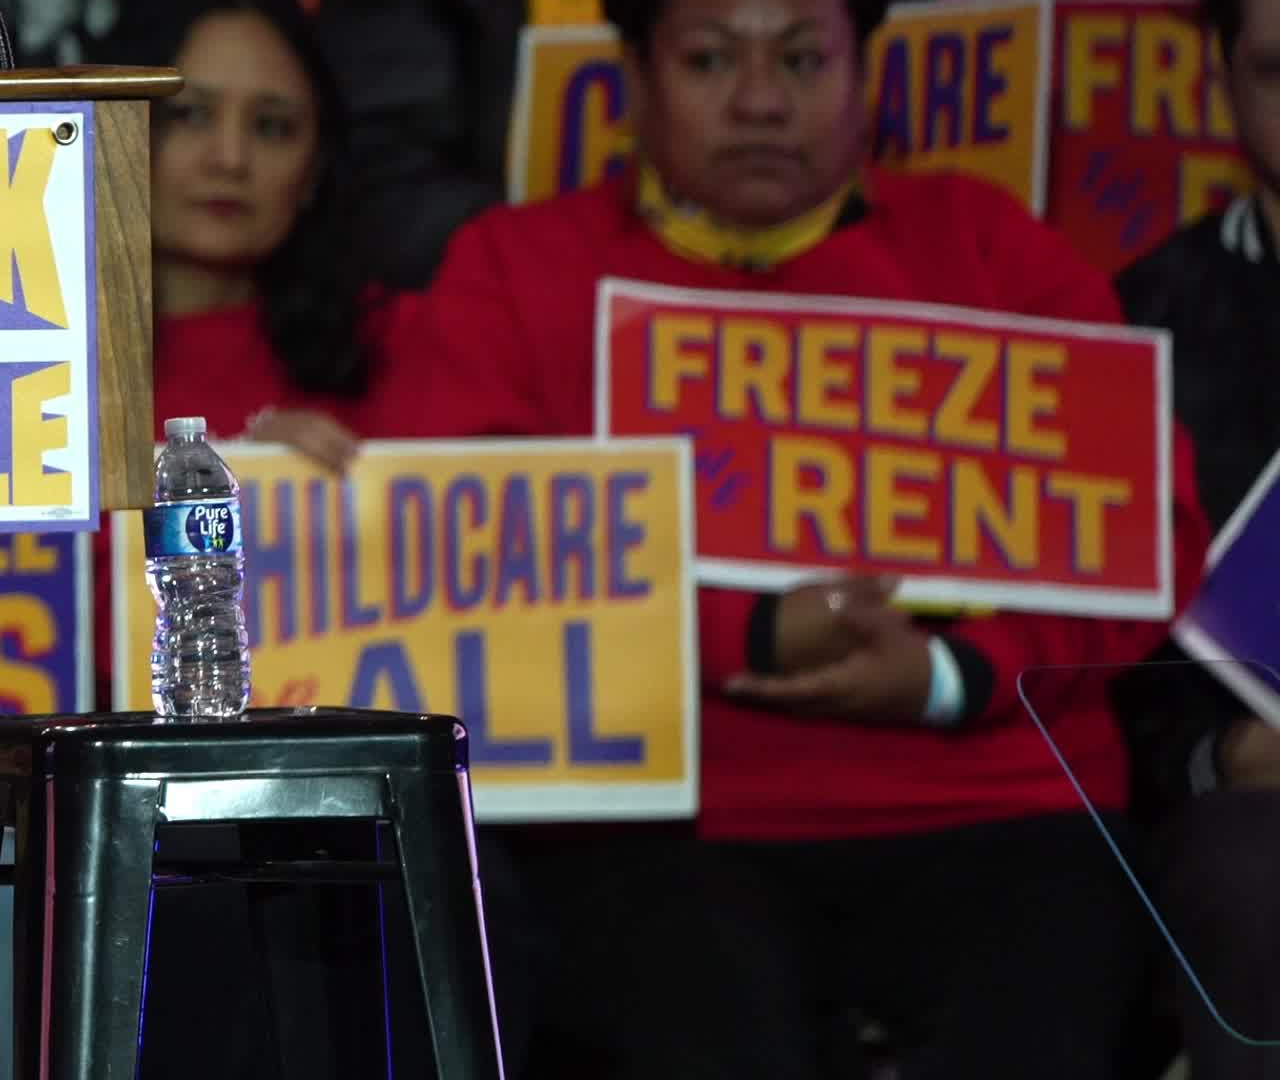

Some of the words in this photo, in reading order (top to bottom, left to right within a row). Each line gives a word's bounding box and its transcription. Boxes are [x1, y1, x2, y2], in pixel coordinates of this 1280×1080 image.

[645, 311, 1069, 463] FREEZE
[195, 505, 229, 521] Pure
[199, 520, 227, 539] Life
[240, 470, 652, 655] HILDCARE
[767, 433, 1133, 578] RENT
[343, 622, 647, 770] ALL
